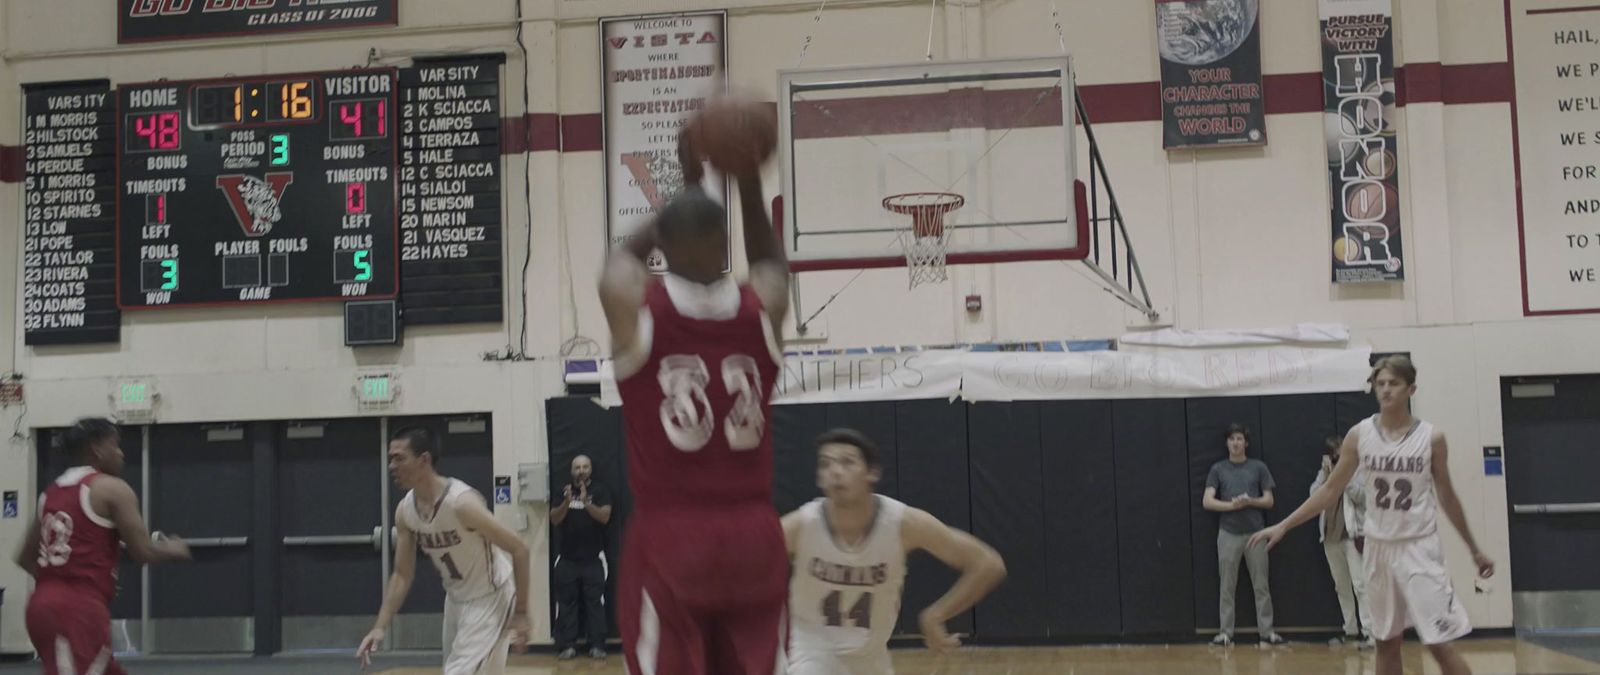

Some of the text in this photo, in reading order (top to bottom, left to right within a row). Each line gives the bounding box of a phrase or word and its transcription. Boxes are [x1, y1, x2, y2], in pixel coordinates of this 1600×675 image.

[247, 6, 378, 25] CLASS OF 2006
[1328, 14, 1384, 26] PURSUE
[633, 19, 692, 30] WELCOME TO
[1326, 26, 1387, 38] VICTORY
[608, 31, 718, 49] VISTA
[1338, 40, 1376, 50] WITH
[1554, 30, 1599, 45] HAIL,
[648, 53, 679, 61] WHERE
[1188, 68, 1231, 83] YOUR
[1556, 64, 1582, 78] WE
[325, 75, 390, 96] VISITOR
[418, 84, 466, 101] MOLINA
[652, 86, 677, 95] IS AN
[1164, 83, 1259, 103] CHARACTER
[129, 88, 177, 108] HOME
[234, 82, 311, 122] 1:16
[403, 99, 491, 118] 2 K SCIACCA
[1174, 103, 1250, 117] CHANGES THE
[36, 114, 46, 128] M
[50, 112, 97, 127] MORRIS
[340, 101, 385, 137] 41
[404, 116, 473, 133] 3 CAMPOS
[641, 121, 653, 130] SO
[1179, 117, 1246, 136] WORLD
[26, 127, 98, 144] 2 HILSTOCK
[135, 111, 179, 150] 48
[231, 130, 255, 142] POSS
[403, 131, 480, 149] 4 TERRAZA
[1561, 132, 1586, 146] WE
[26, 143, 93, 159] 3 SAMUELS
[220, 141, 265, 157] PERIOD
[271, 134, 288, 165] 3
[323, 145, 365, 160] BONUS
[403, 148, 453, 164] 5 HALE
[26, 158, 84, 174] 4 PERDUE
[147, 154, 188, 170] BONUS
[1335, 53, 1392, 265] HONOR
[326, 167, 387, 184] TIMEOUTS
[401, 162, 494, 180] 12 C SCIACCA
[1563, 165, 1596, 180] FOR
[26, 177, 35, 190] 5
[48, 173, 95, 188] MORRIS
[126, 178, 186, 195] TIMEOUTS
[402, 182, 416, 196] 14
[26, 189, 95, 205] 10 SPIRITO
[402, 195, 474, 212] 15 NEWSOM
[27, 204, 101, 220] 12 STARNES
[157, 193, 165, 224] 1
[1565, 199, 1600, 215] AND
[342, 214, 372, 229] LEFT
[401, 211, 466, 229] 20 MARIN
[26, 221, 67, 236] 13 LOW
[142, 224, 171, 239] LEFT
[403, 226, 485, 244] 21 VASQUEZ
[25, 235, 73, 251] 21 POPE
[215, 238, 308, 256] PLAYER FOULS
[334, 235, 373, 250] FOULS
[1566, 234, 1588, 248] TO
[25, 250, 94, 266] 22 TAYLOR
[140, 244, 179, 260] FOULS
[401, 244, 468, 260] 22 HAYES
[353, 250, 371, 281] 5
[25, 266, 88, 282] 23 RIVERA
[160, 259, 177, 290] 3
[1569, 268, 1596, 282] WE
[25, 282, 85, 297] 24 COATS
[240, 286, 271, 300] GAME
[341, 283, 367, 296] WON
[25, 297, 86, 313] 30 ADAMS
[146, 291, 171, 305] WON
[24, 312, 85, 328] 32 FLYNN
[1374, 478, 1412, 511] 22
[440, 551, 463, 580] 1
[820, 590, 873, 629] 44
